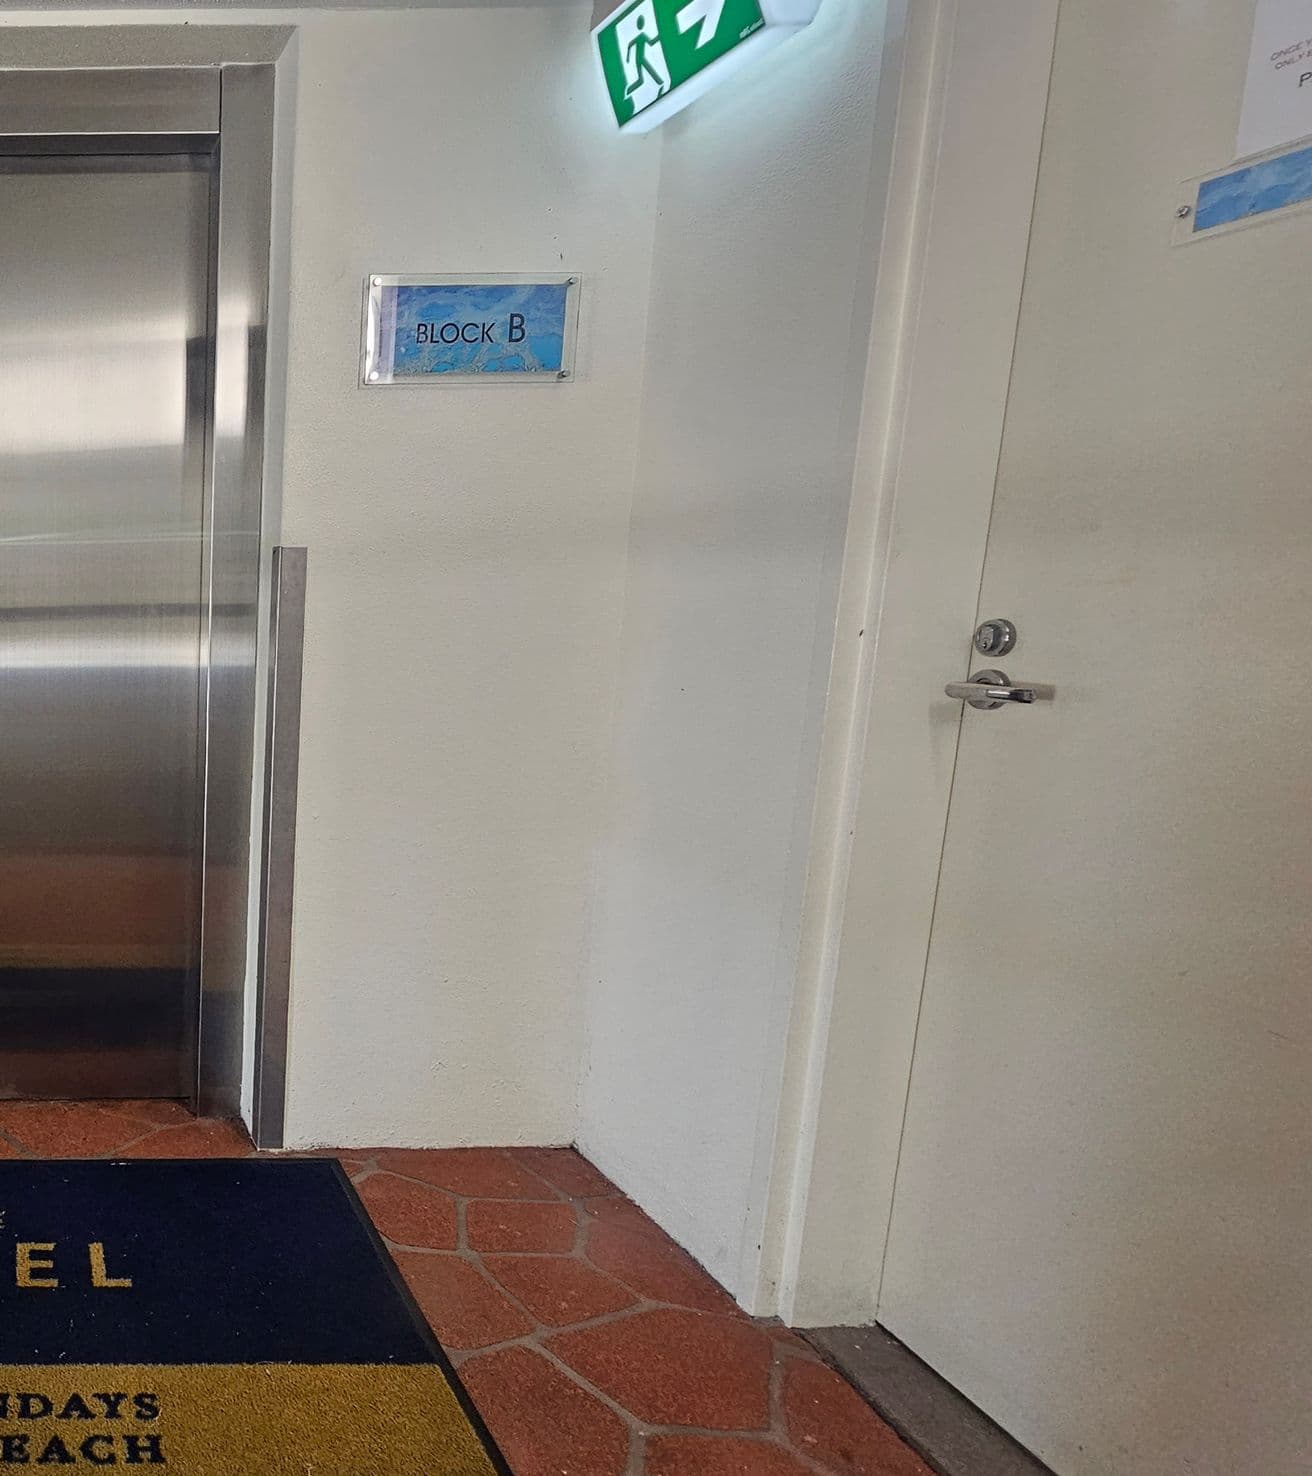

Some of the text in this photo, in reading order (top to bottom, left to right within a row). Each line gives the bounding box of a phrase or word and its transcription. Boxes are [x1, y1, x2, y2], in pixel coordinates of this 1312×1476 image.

[1299, 71, 1312, 87] P
[416, 313, 527, 344] BLOCK B
